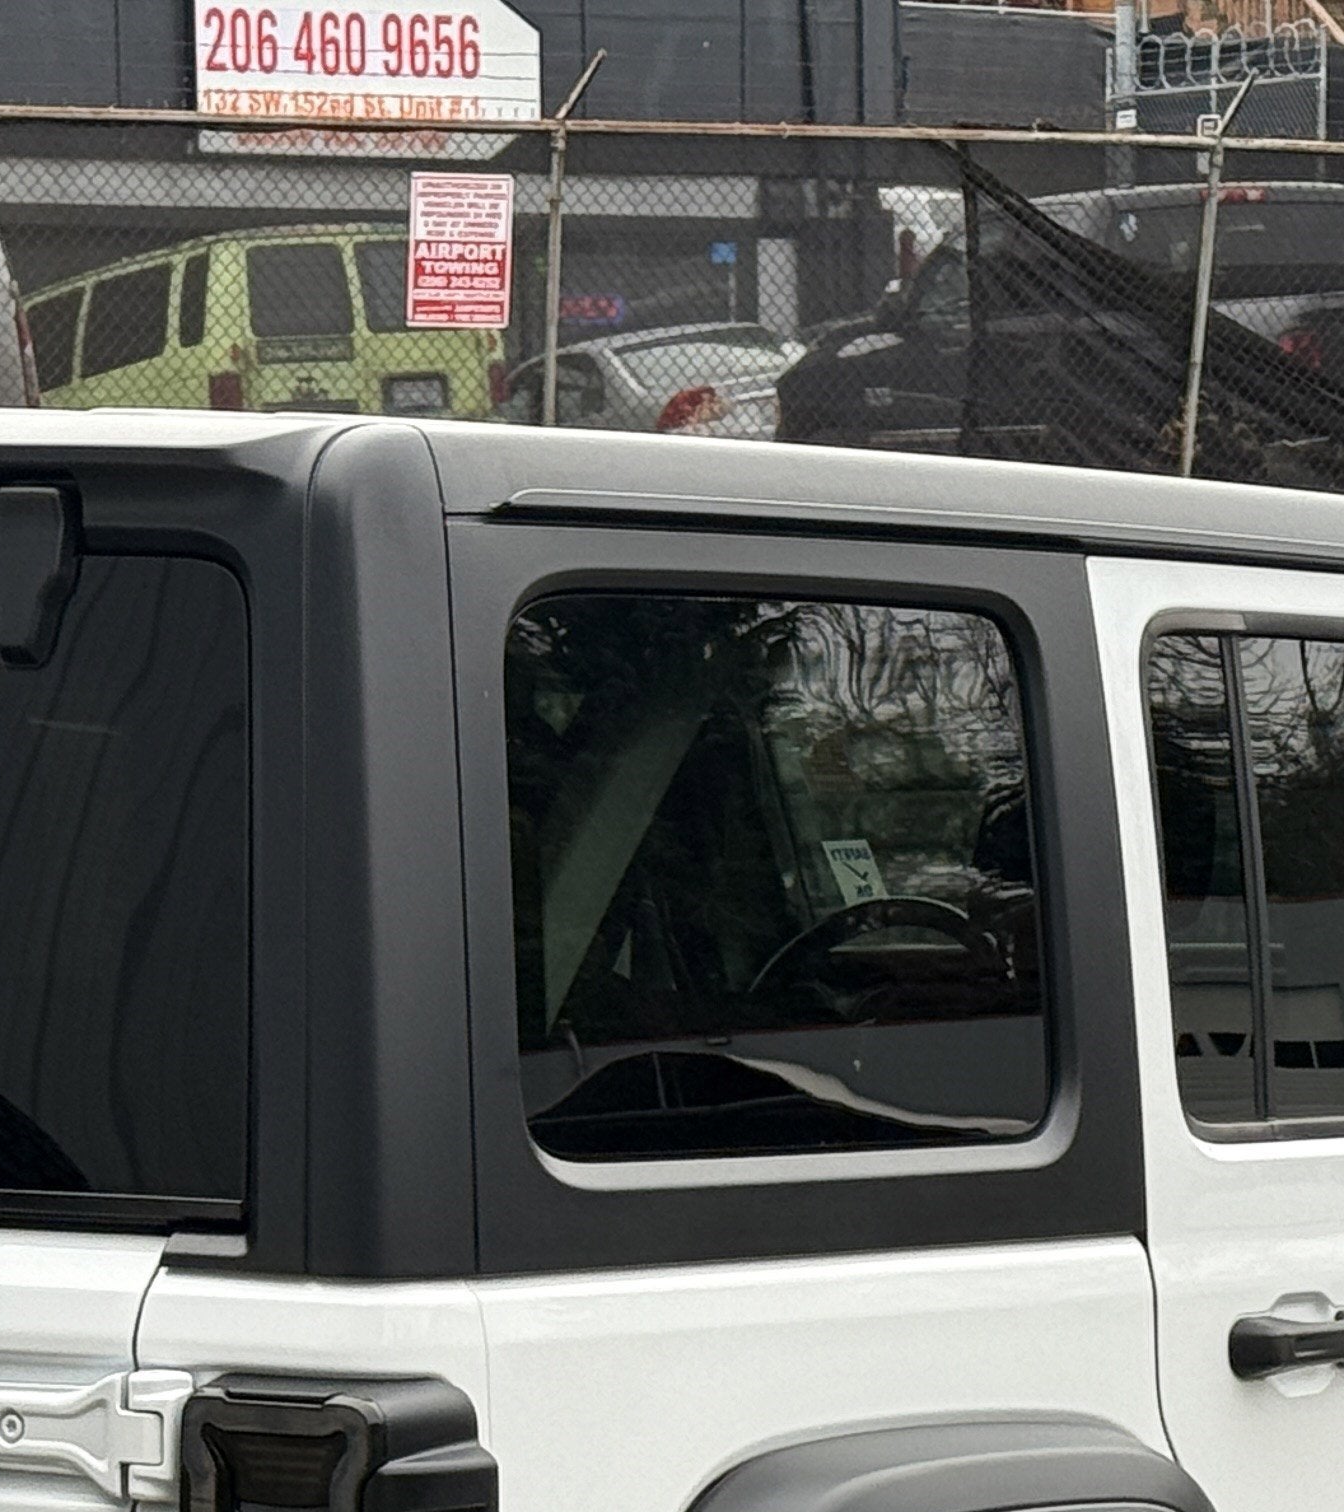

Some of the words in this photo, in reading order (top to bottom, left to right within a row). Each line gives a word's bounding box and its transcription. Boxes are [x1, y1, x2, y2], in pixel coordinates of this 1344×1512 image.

[204, 7, 278, 75] 206
[294, 11, 367, 77] 460
[382, 13, 481, 79] 9656
[203, 89, 239, 113] 132
[399, 95, 442, 119] Unit
[414, 242, 506, 262] AIRPORT
[420, 260, 500, 275] TOWING
